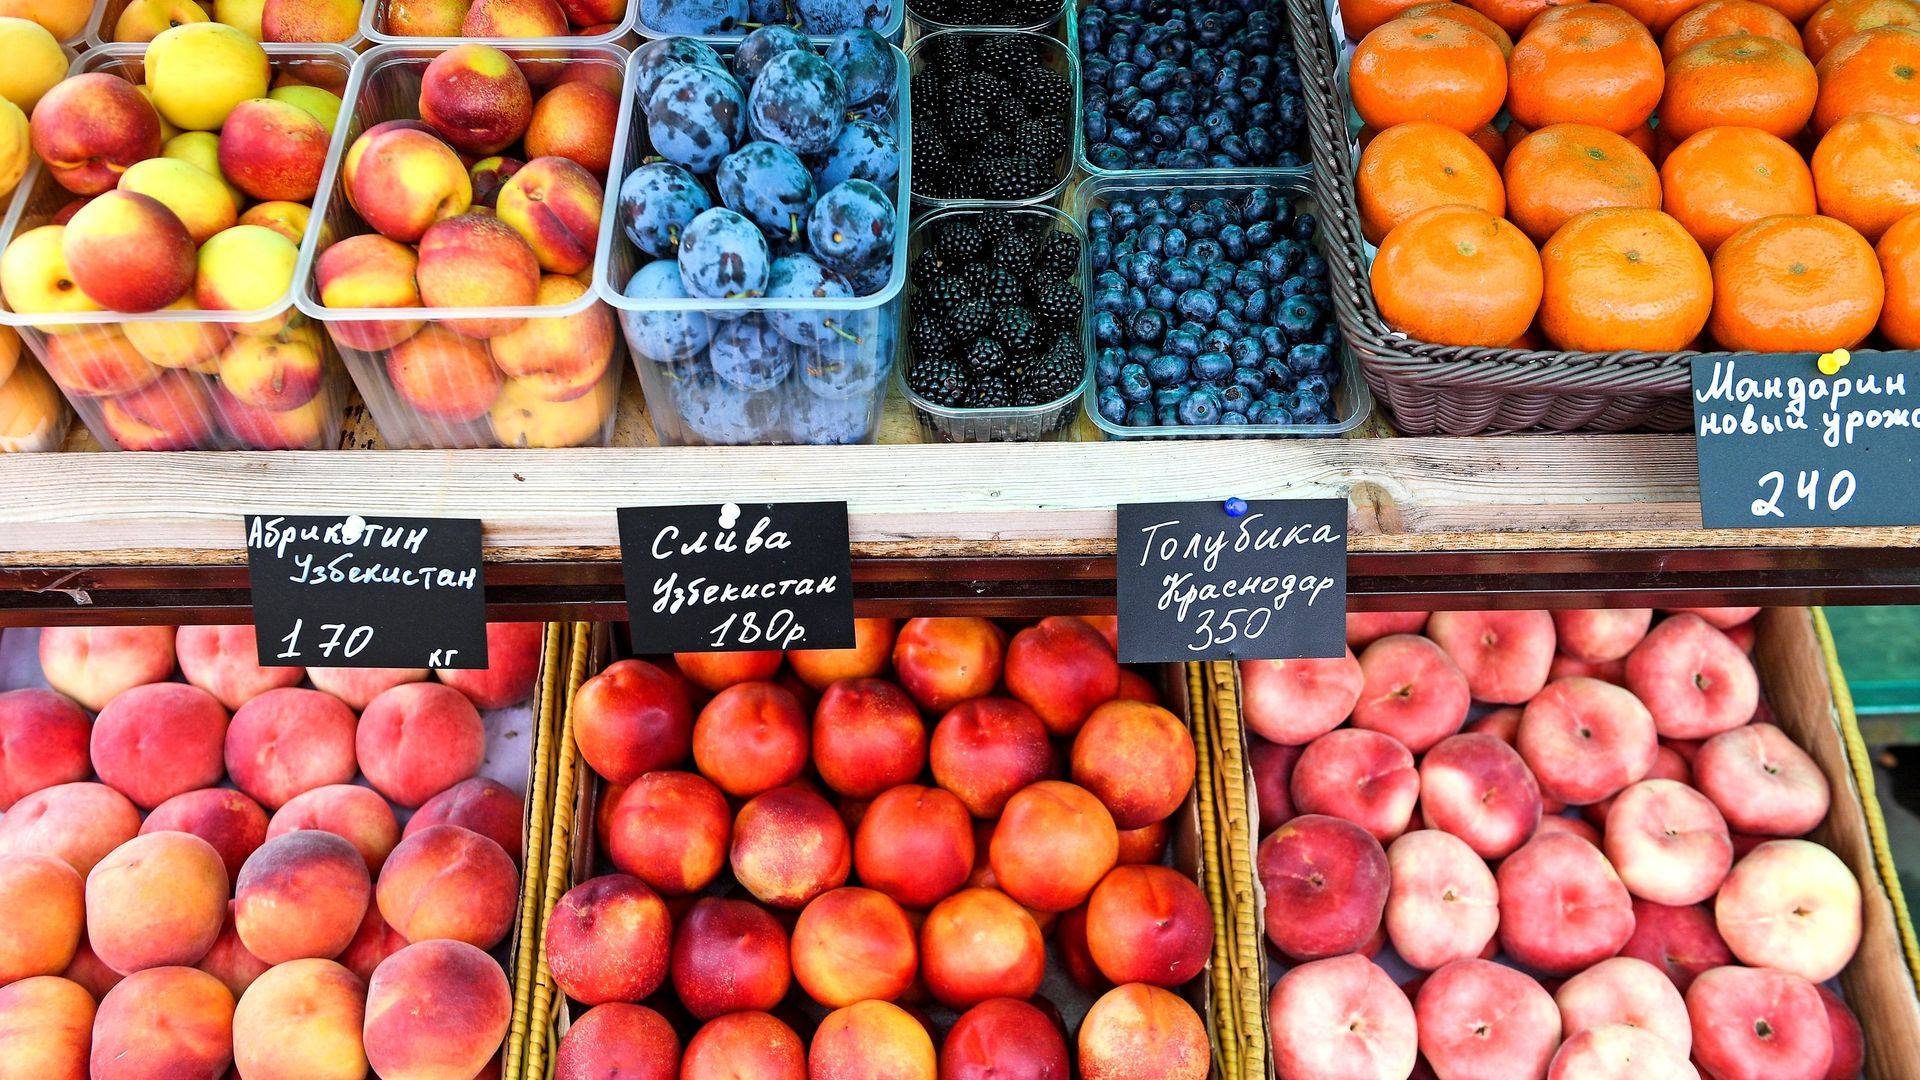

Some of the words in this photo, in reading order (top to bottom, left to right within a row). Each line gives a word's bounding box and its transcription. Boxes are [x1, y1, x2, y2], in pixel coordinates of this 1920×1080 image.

[1695, 360, 1906, 412] Мандарин
[1750, 469, 1857, 518] 240
[651, 516, 792, 560] Слива
[289, 552, 477, 590] Узбекистан
[652, 572, 838, 615] Узбекистан
[1157, 572, 1335, 622] Краснодар
[1187, 607, 1272, 651] 350
[428, 648, 459, 668] кг
